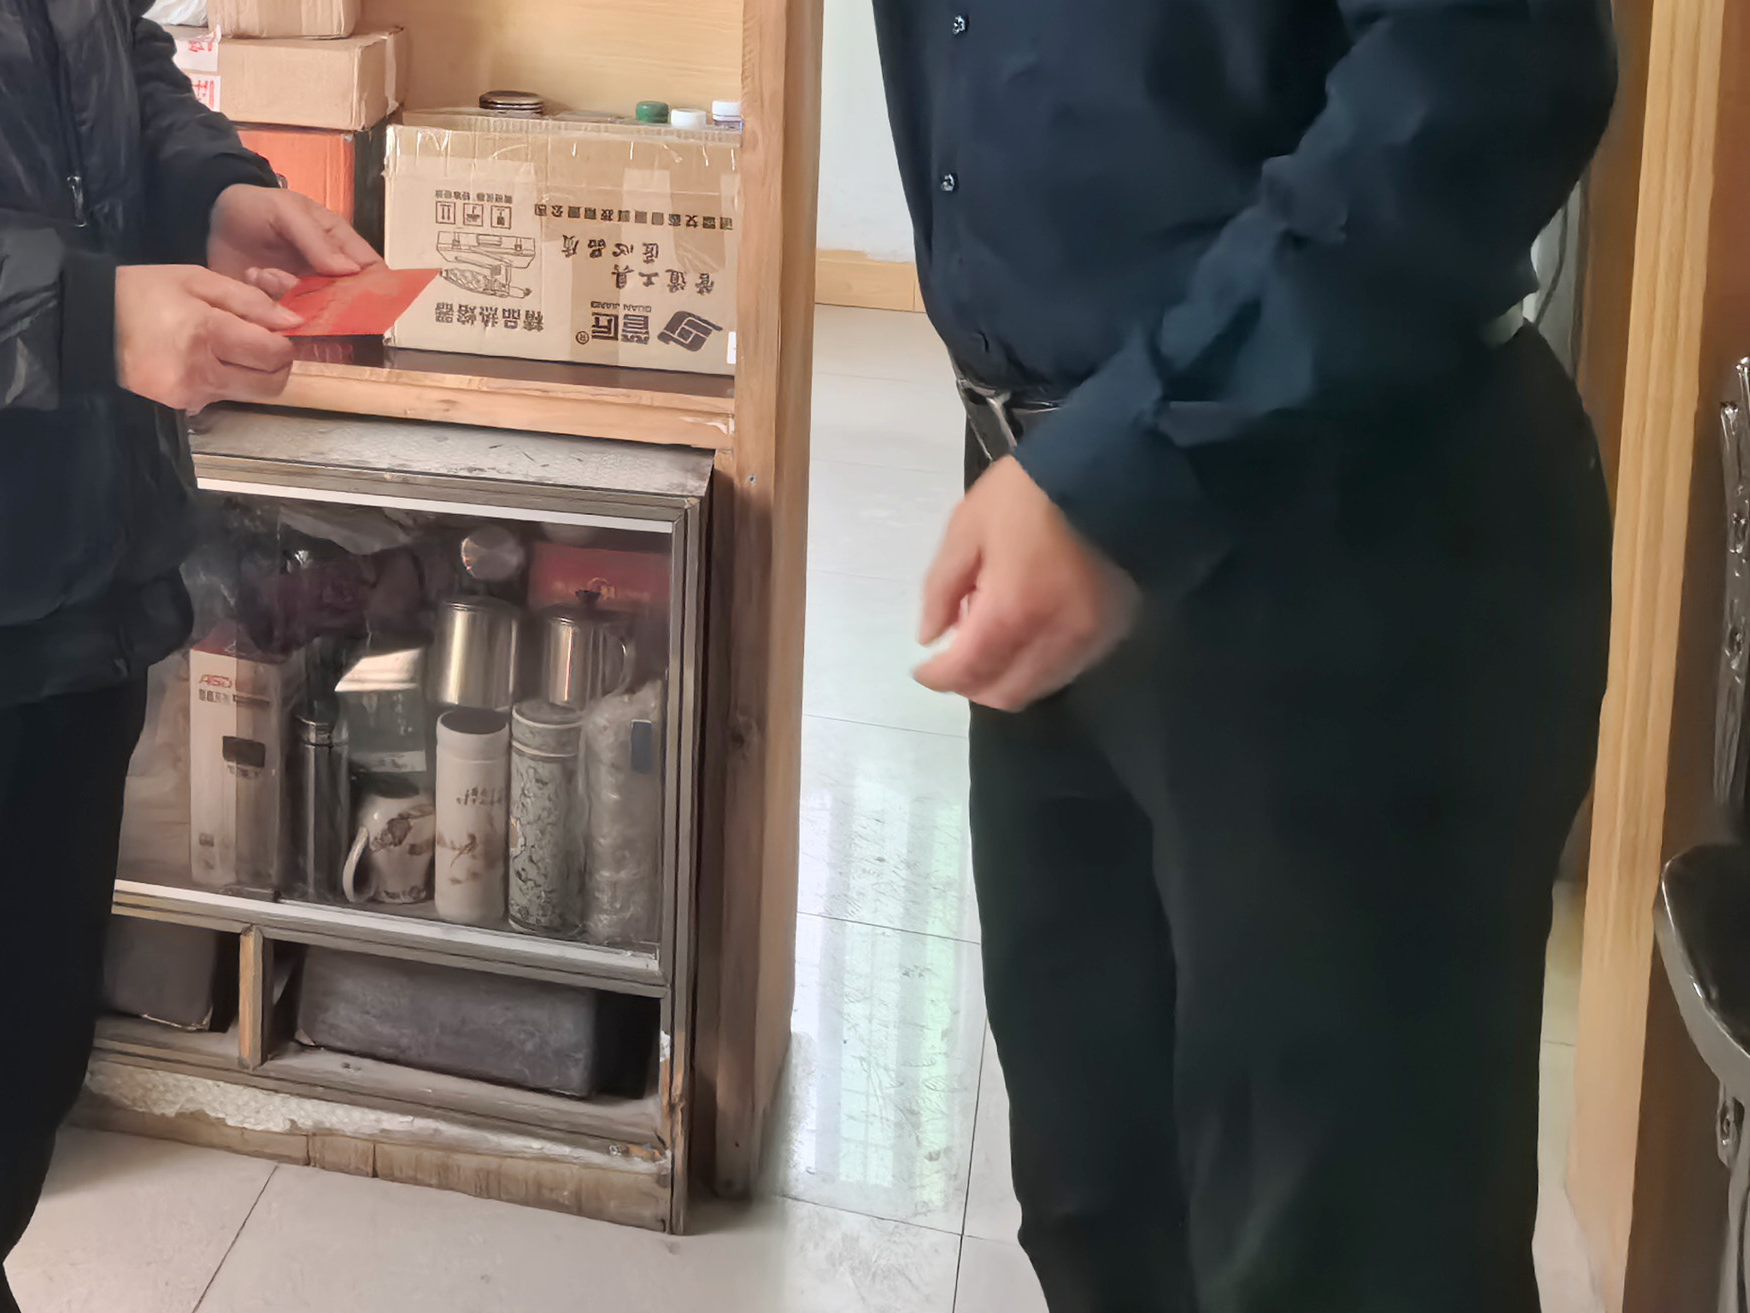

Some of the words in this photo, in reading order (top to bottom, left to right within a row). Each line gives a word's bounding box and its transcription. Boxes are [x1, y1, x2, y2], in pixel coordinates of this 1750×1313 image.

[562, 235, 660, 264] 匠心品质
[611, 264, 714, 295] 管道工具
[435, 302, 544, 332] 精品热熔器
[591, 312, 650, 345] 管匠
[199, 674, 233, 689] ASD
